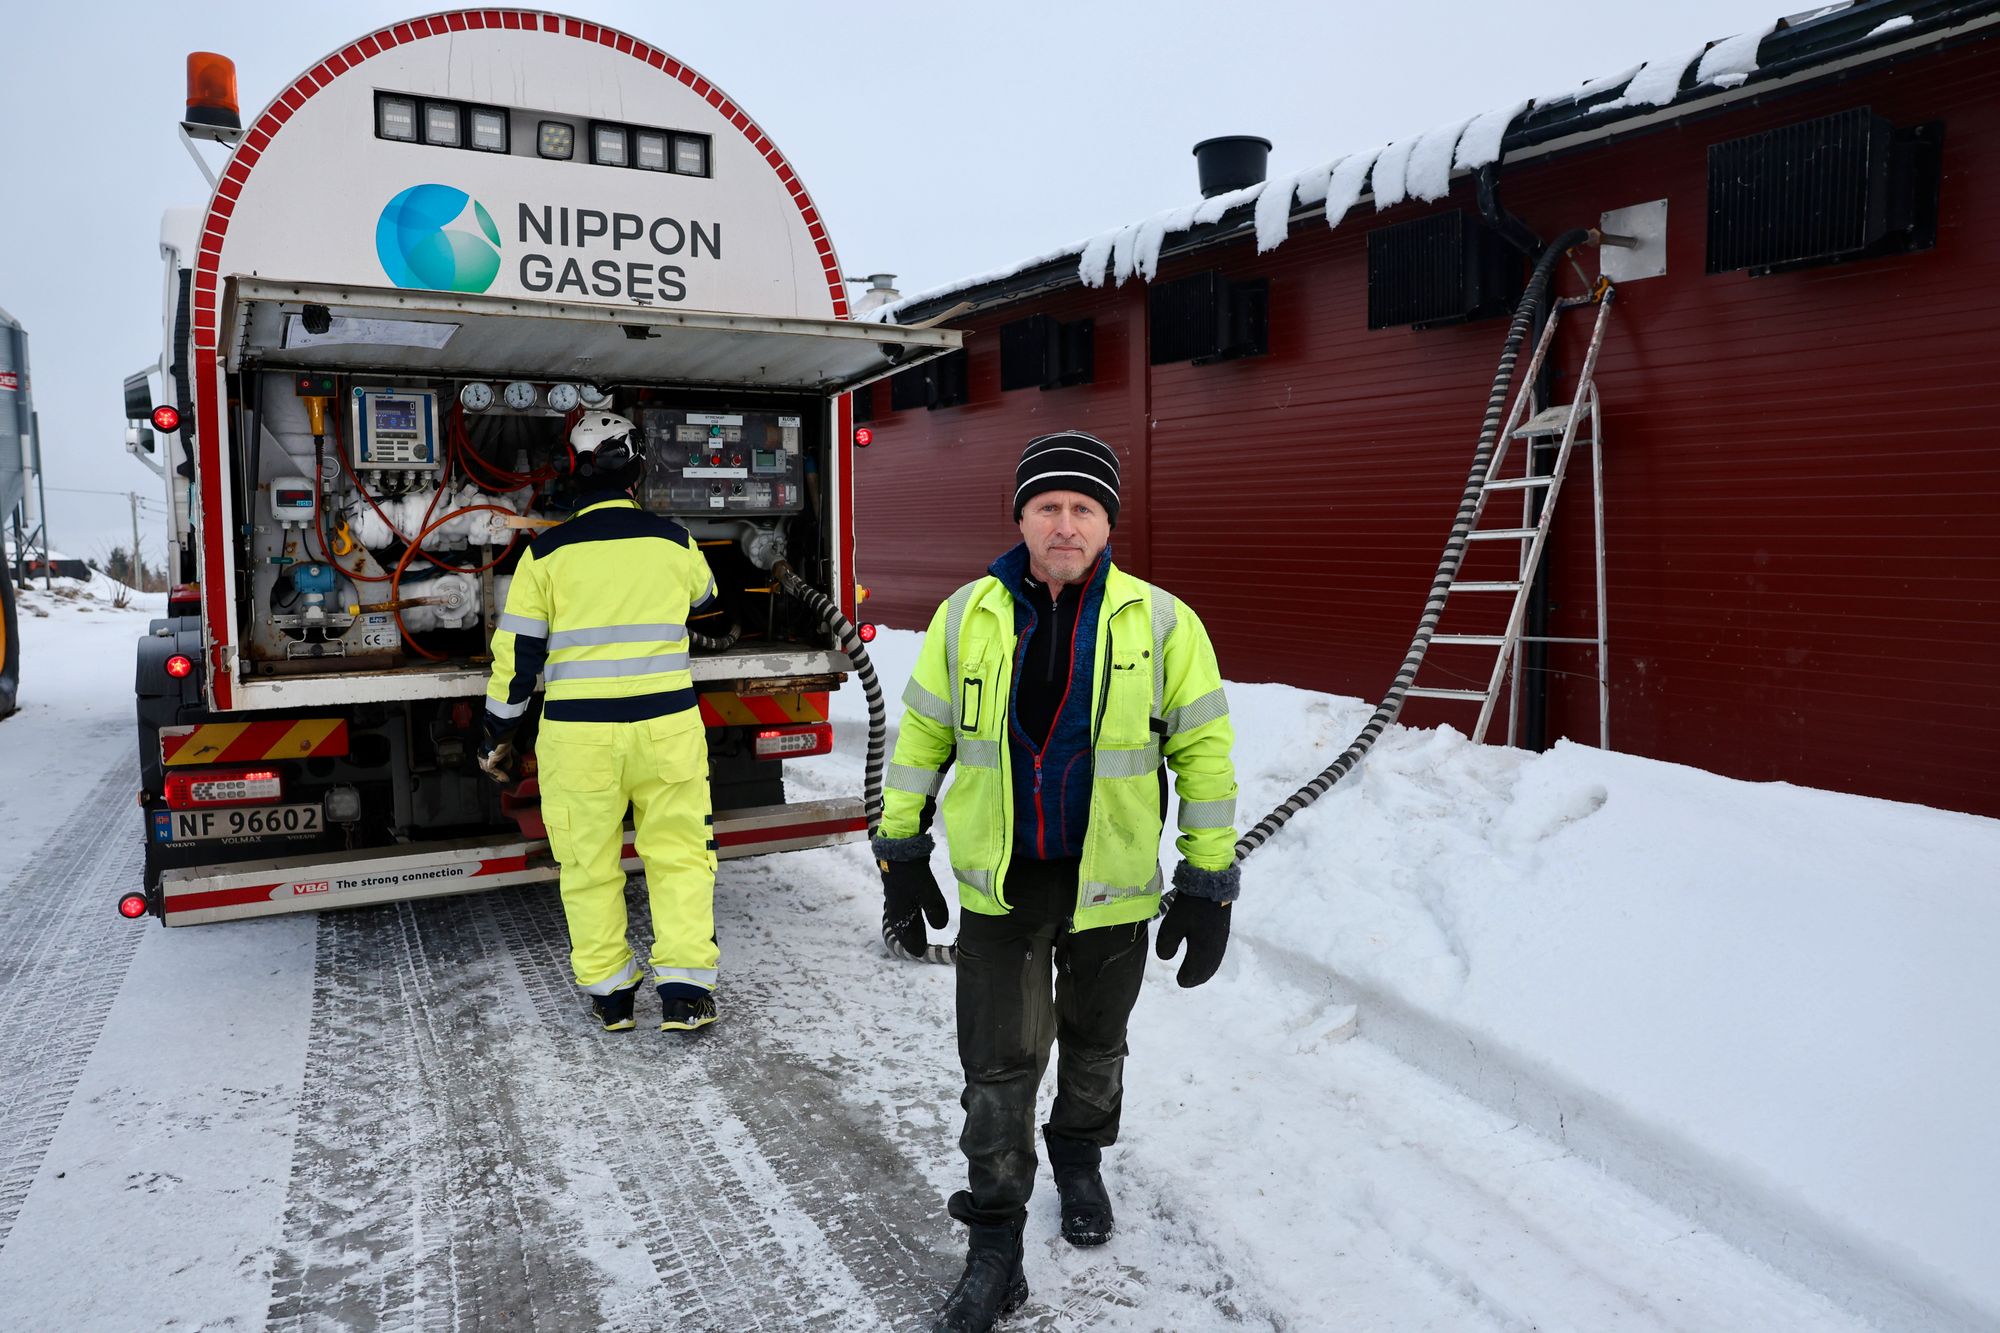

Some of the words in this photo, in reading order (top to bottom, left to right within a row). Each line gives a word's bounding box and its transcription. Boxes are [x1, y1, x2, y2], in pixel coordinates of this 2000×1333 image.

[518, 202, 721, 260] NIPPON
[519, 254, 687, 302] GASES
[179, 812, 215, 837] NF
[229, 807, 318, 835] 96602
[160, 830, 168, 838] N
[221, 835, 262, 845] VOLMAX
[165, 841, 196, 849] VOLVO
[336, 879, 358, 889] The
[361, 876, 399, 887] strong
[402, 868, 464, 882] connection
[294, 882, 329, 895] VBG
